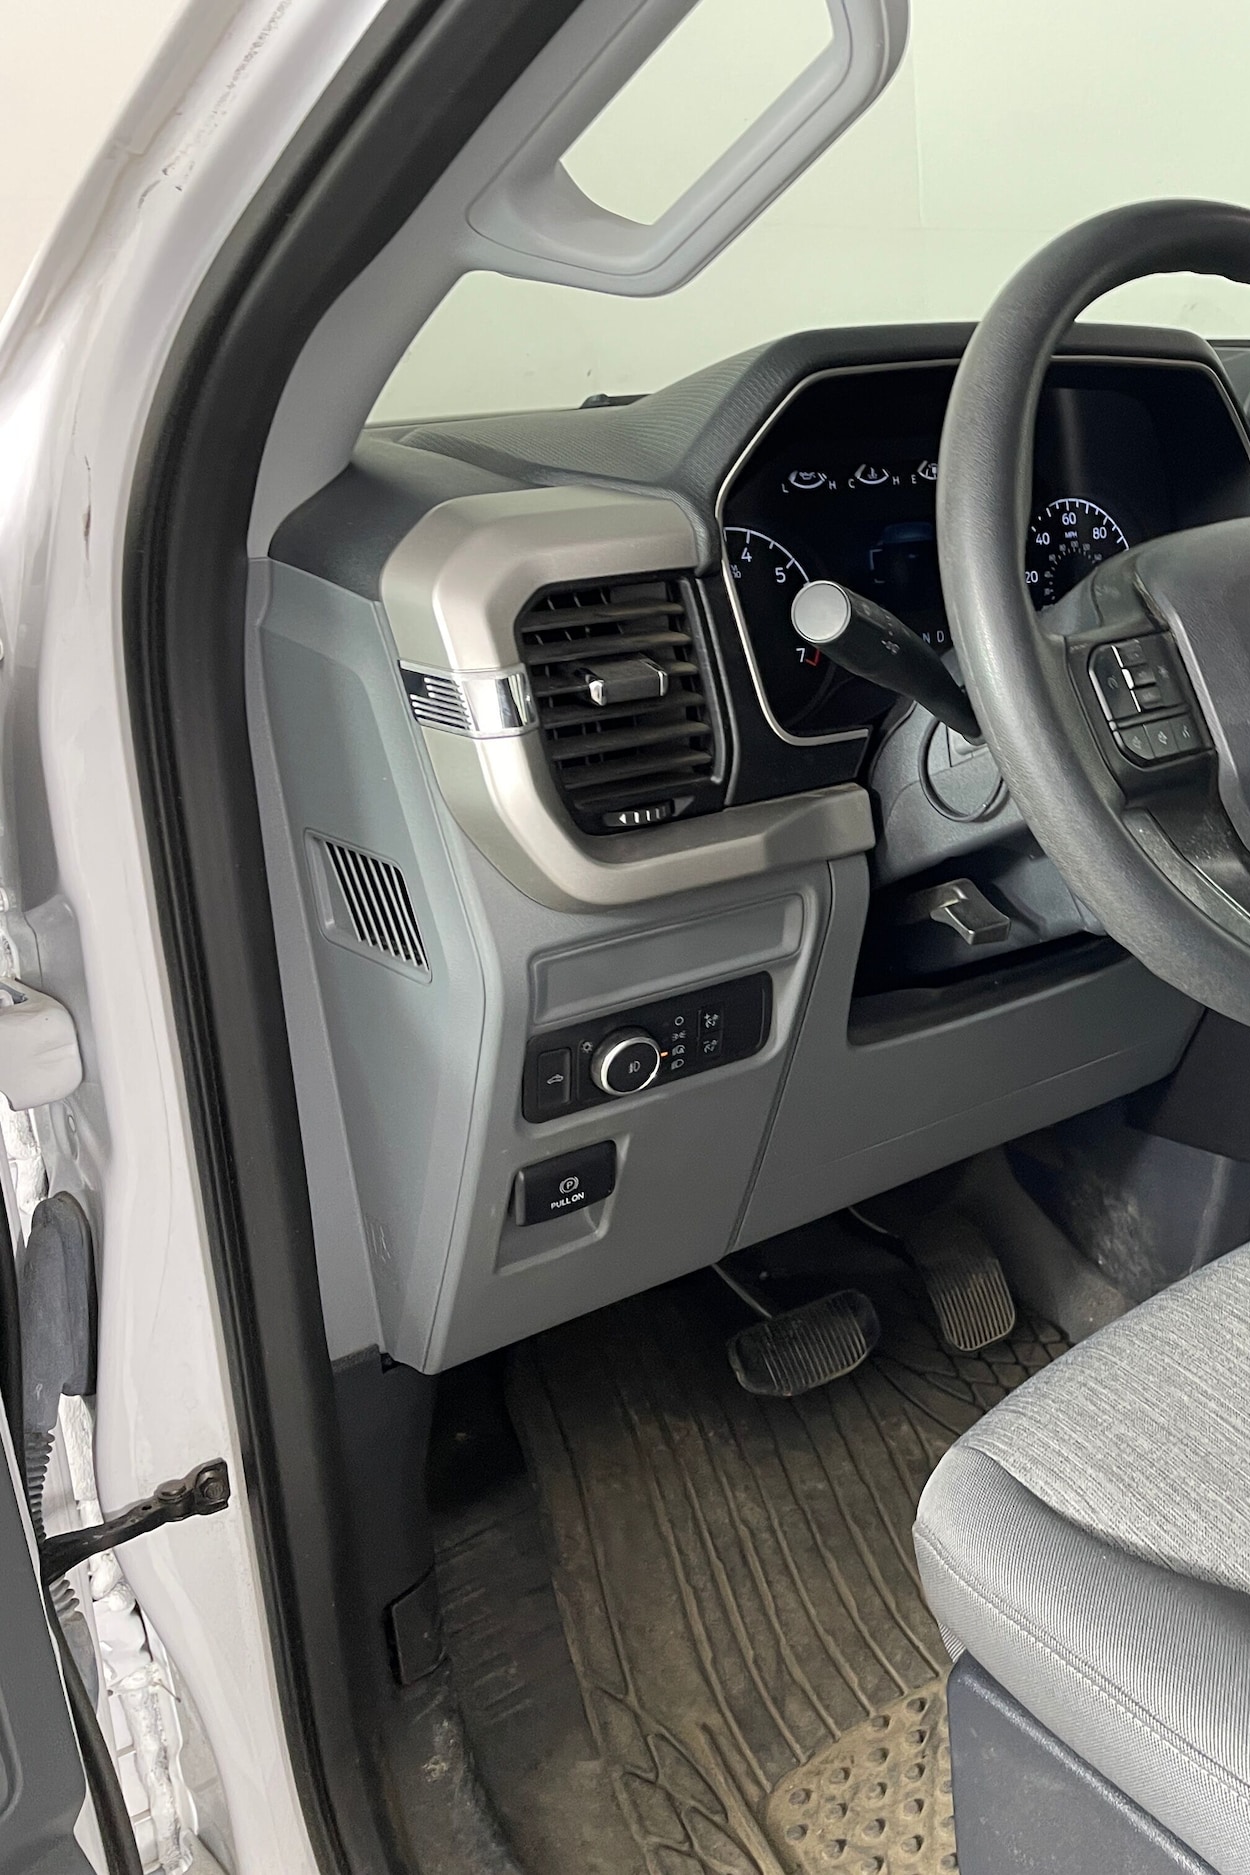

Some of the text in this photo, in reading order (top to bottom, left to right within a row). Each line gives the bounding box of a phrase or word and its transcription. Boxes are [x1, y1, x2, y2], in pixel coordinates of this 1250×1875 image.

[828, 480, 837, 490] H
[848, 478, 856, 489] C
[892, 475, 900, 486] H
[911, 474, 918, 484] E
[781, 483, 789, 493] L
[1062, 512, 1076, 525] 60
[1035, 532, 1050, 545] 40
[1092, 526, 1107, 540] 80
[741, 546, 752, 563] 4
[775, 567, 786, 583] 5
[1025, 570, 1039, 584] 20
[922, 630, 945, 644] N D
[795, 647, 806, 663] 7
[550, 1192, 585, 1209] PULL ON
